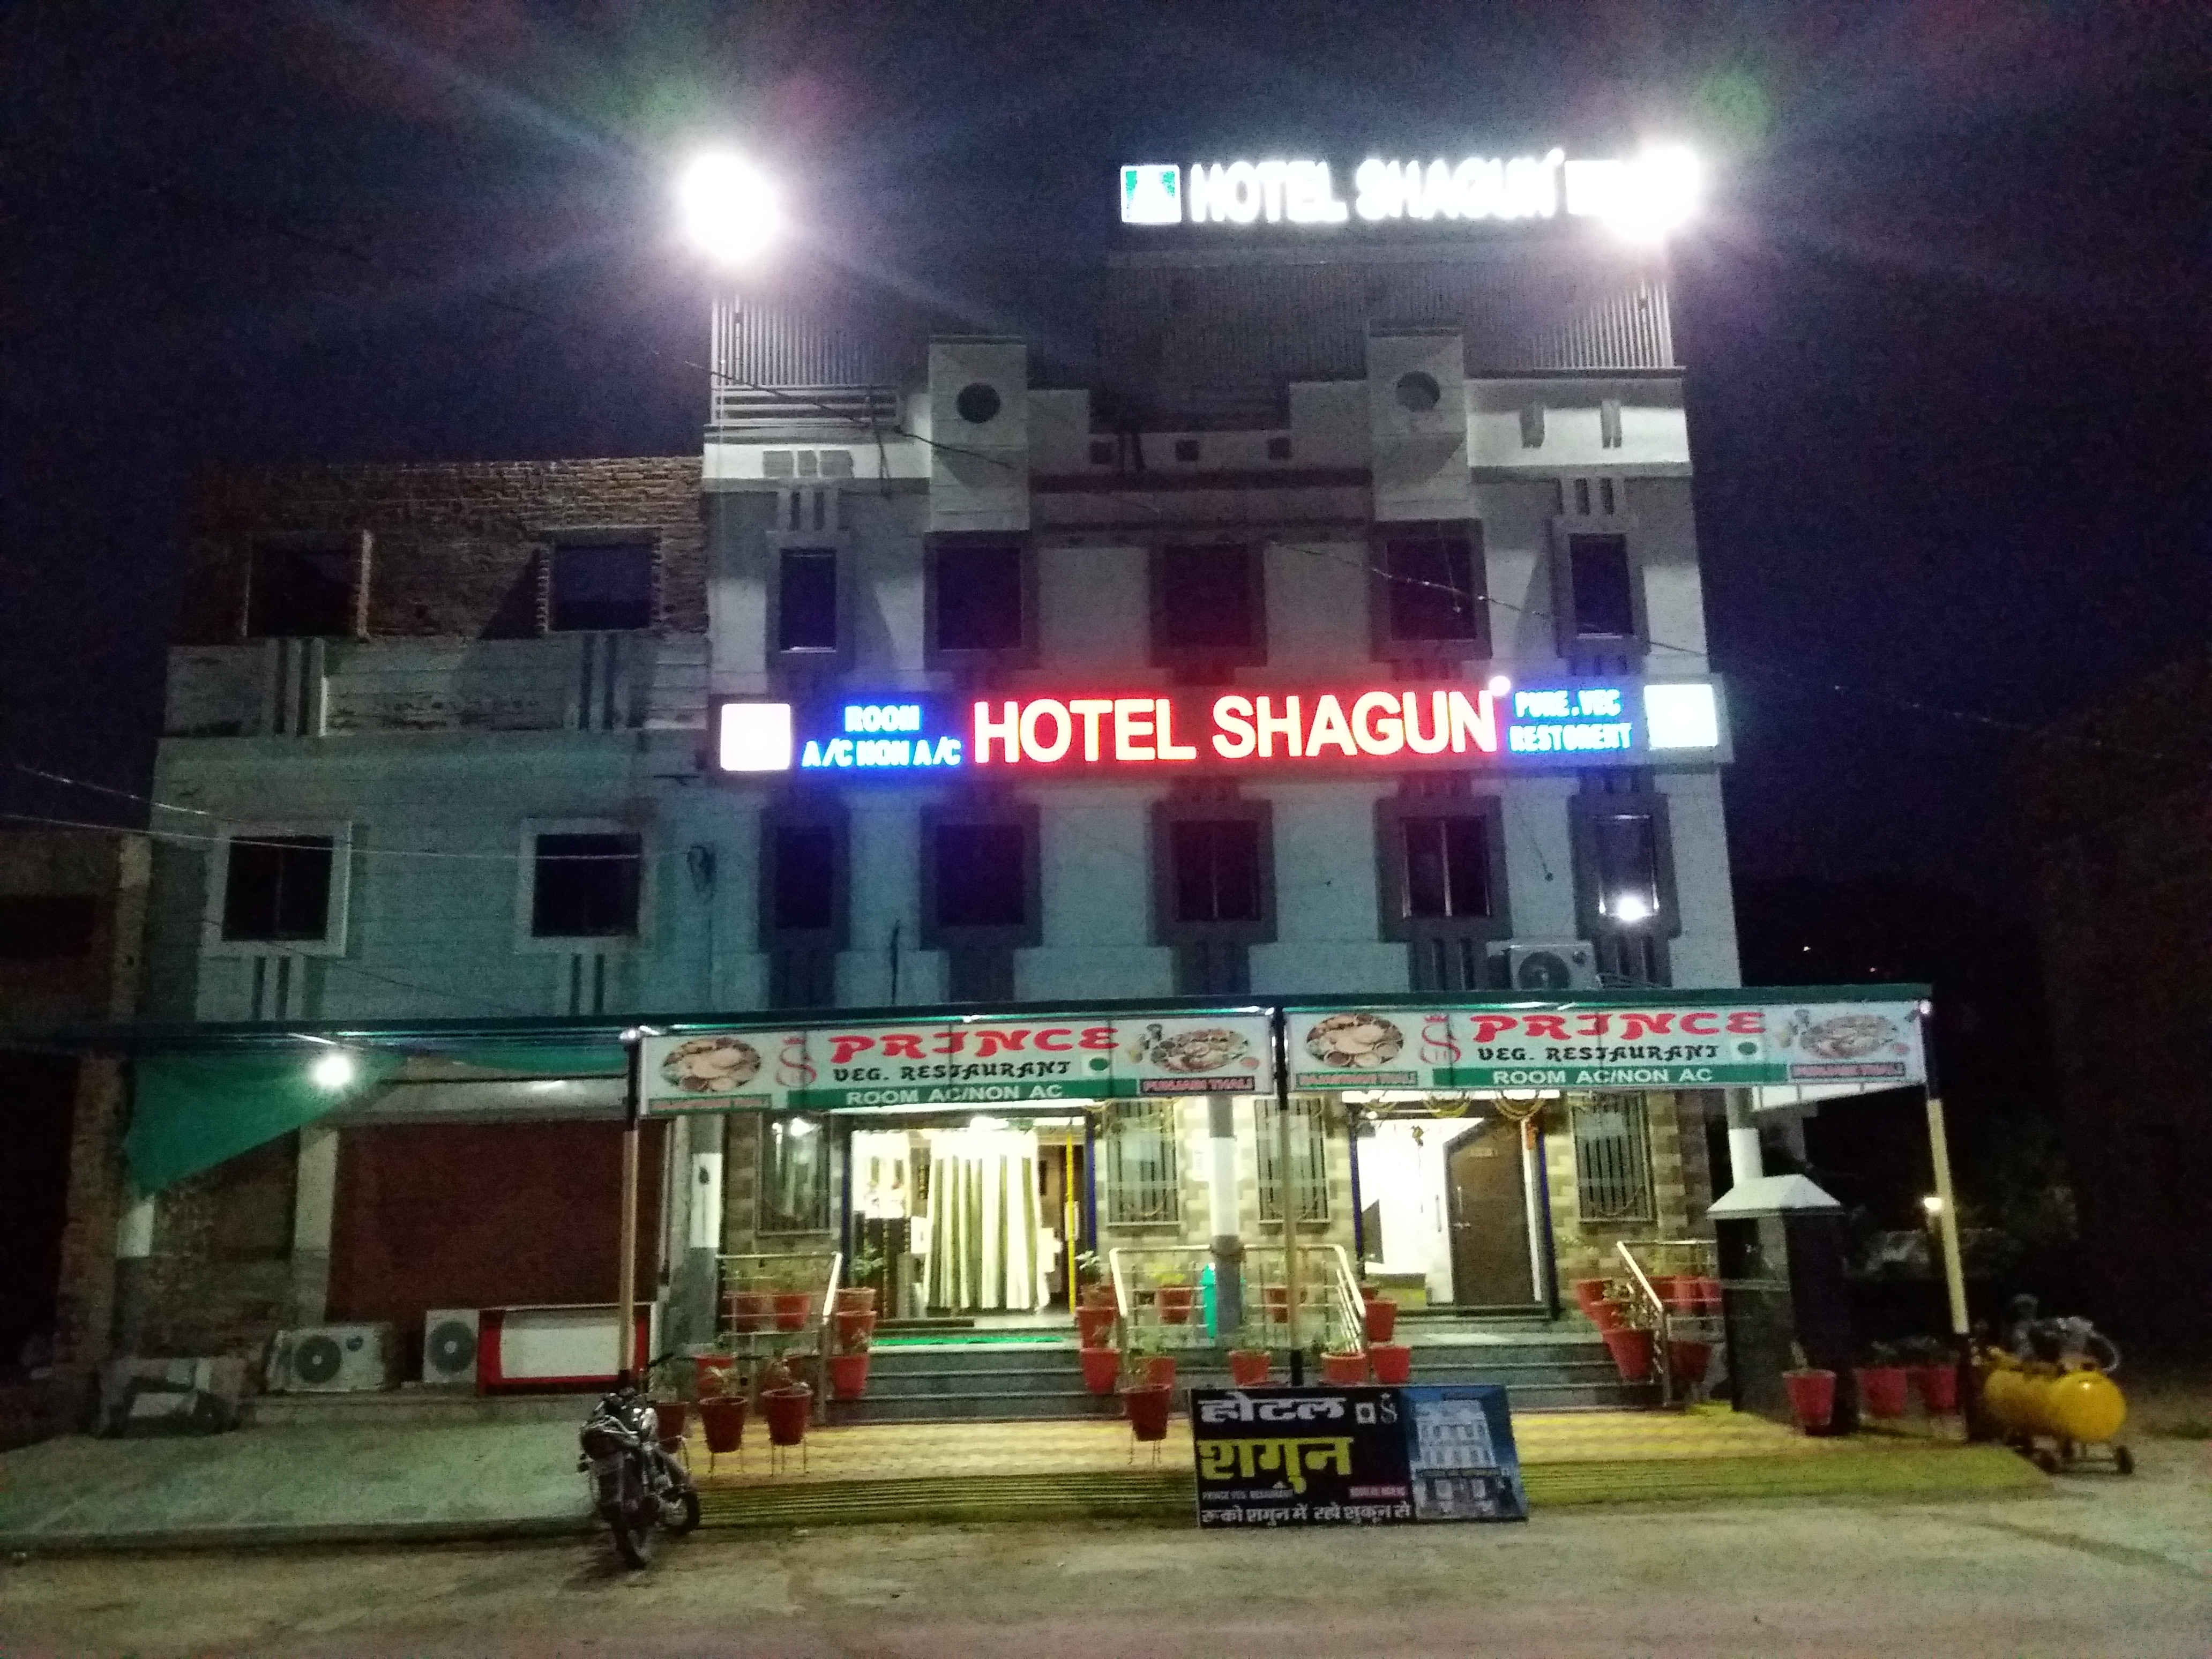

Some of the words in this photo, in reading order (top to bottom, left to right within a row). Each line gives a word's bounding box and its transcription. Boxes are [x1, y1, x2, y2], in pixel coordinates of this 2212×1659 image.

[1190, 160, 1348, 223] HOTEL
[1355, 157, 1557, 221] SHAGUN
[845, 705, 921, 733] ROOM
[975, 699, 1197, 763] HOTEL
[1212, 690, 1497, 759] SHAGUN
[802, 738, 854, 767] A/C
[856, 739, 911, 766] NON
[913, 736, 962, 766] A/C
[1469, 1011, 1766, 1043] PRINCE
[828, 1026, 1119, 1064] PRINCE
[1545, 1044, 1720, 1063] RESTAURANT
[901, 1059, 1071, 1081] RESTAURANT
[1492, 1070, 1566, 1084] ROOM
[1679, 1067, 1713, 1082] AC
[846, 1090, 920, 1104] ROOM
[1029, 1083, 1063, 1098] AC
[1198, 1391, 1347, 1423] होटल
[1197, 1436, 1354, 1493] शगुन
